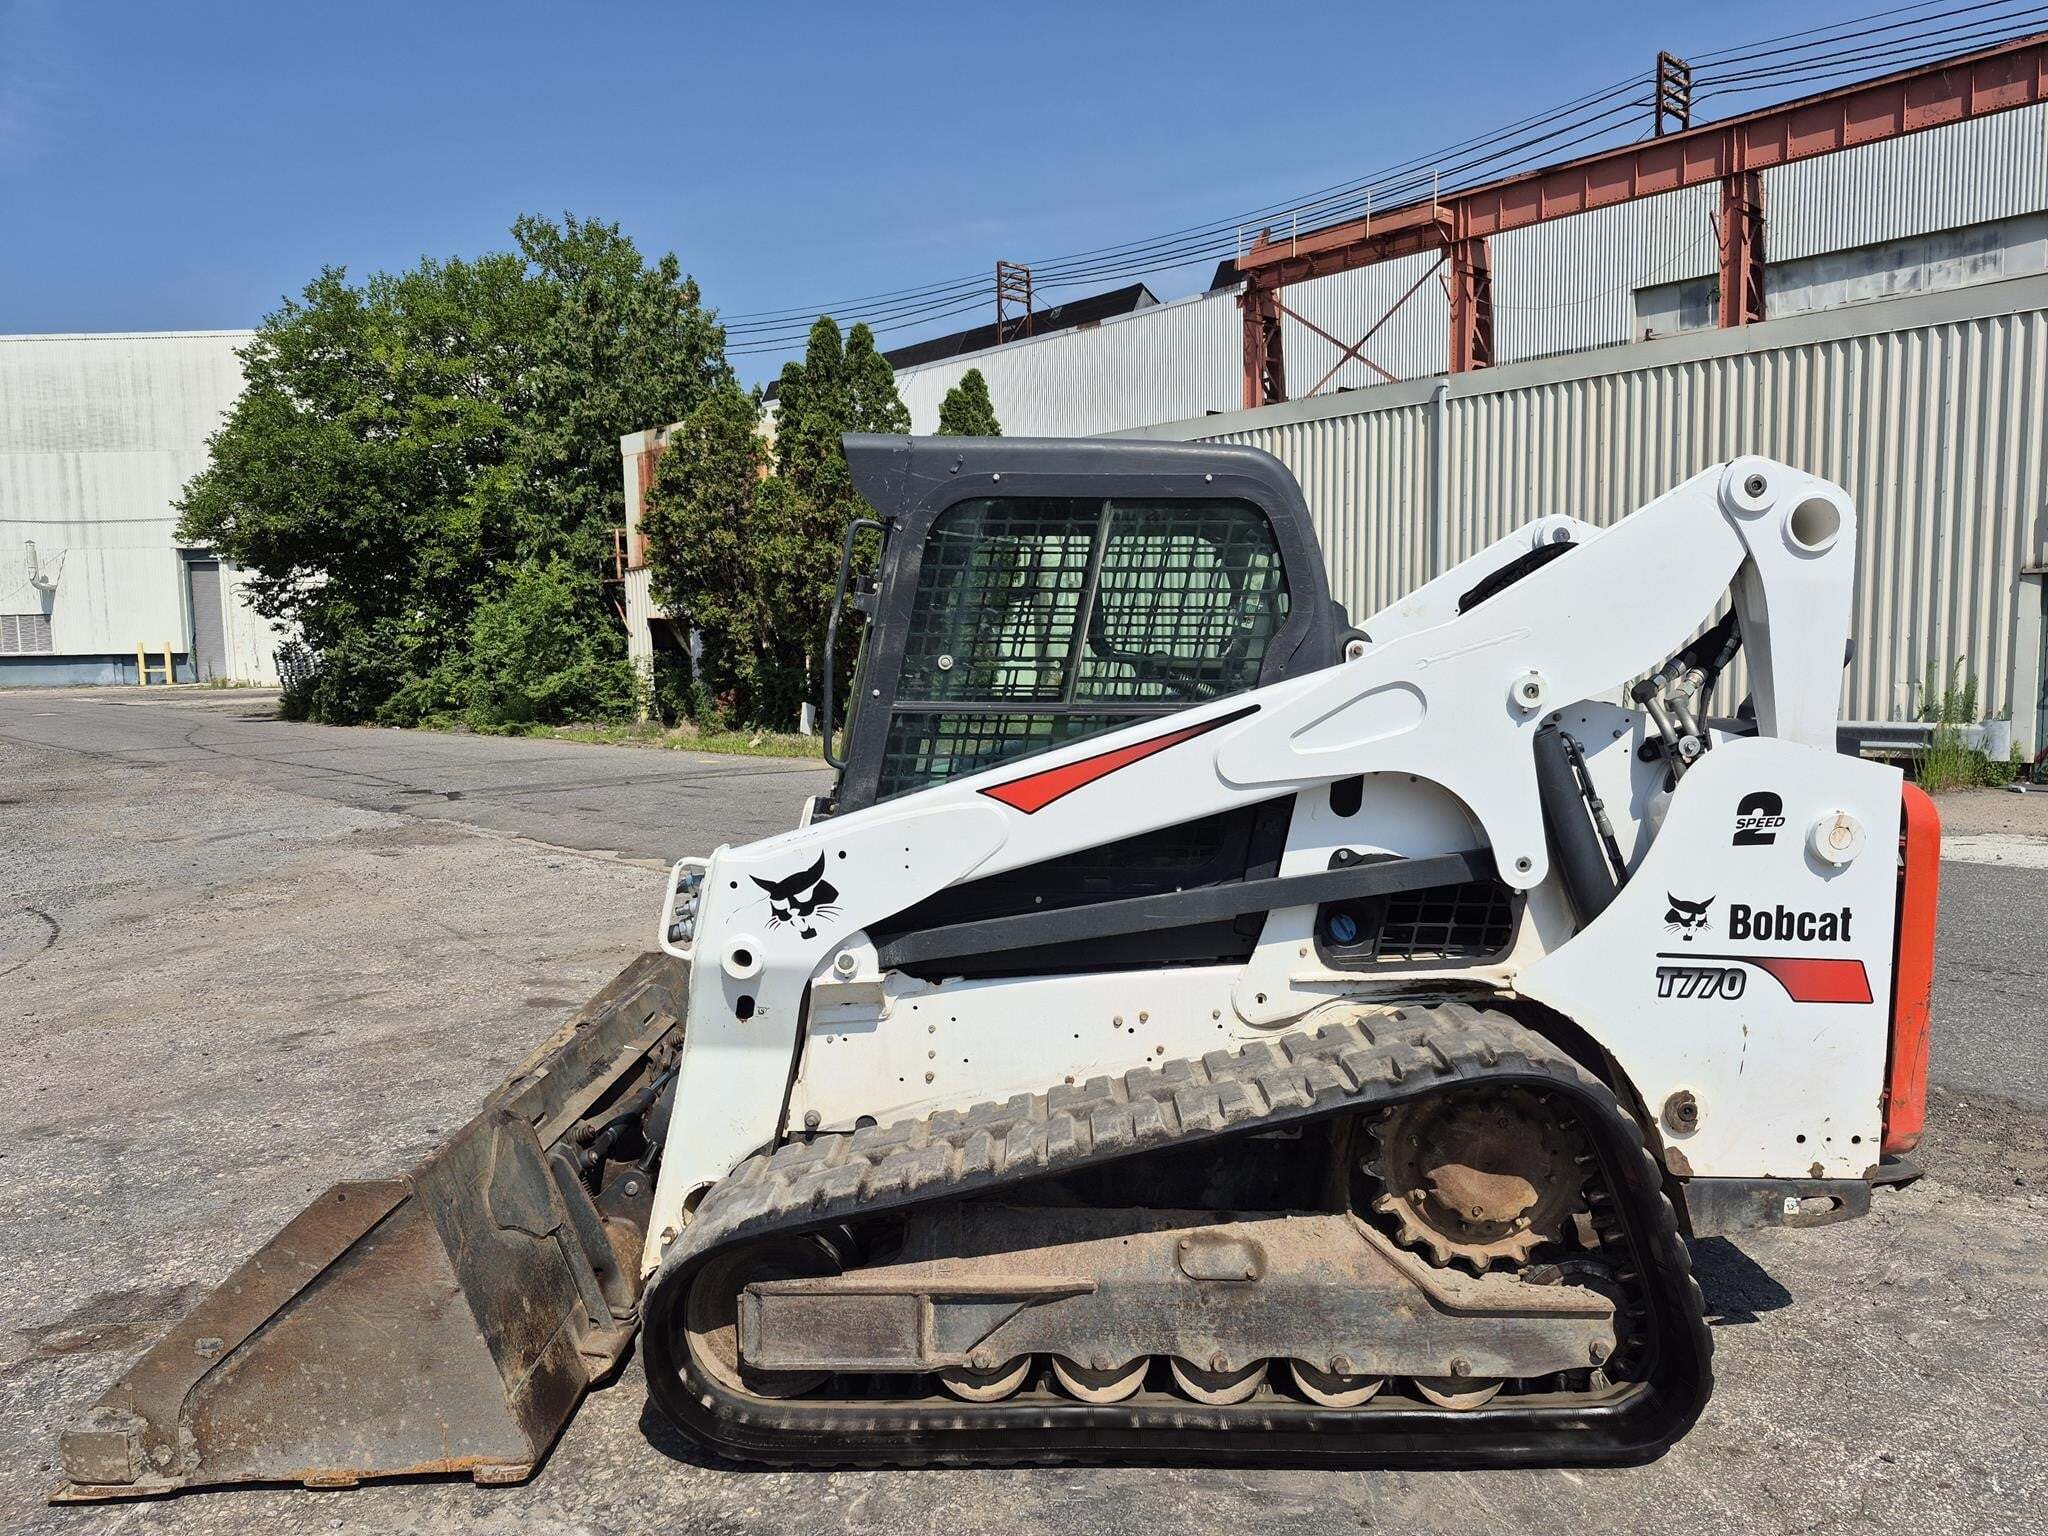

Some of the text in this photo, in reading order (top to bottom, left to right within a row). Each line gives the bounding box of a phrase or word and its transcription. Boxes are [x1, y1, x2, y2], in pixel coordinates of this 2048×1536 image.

[1732, 791, 1783, 846] 2
[1736, 817, 1786, 829] SPEED
[1728, 904, 1852, 942] Bobcat
[1656, 966, 1747, 1000] T770
